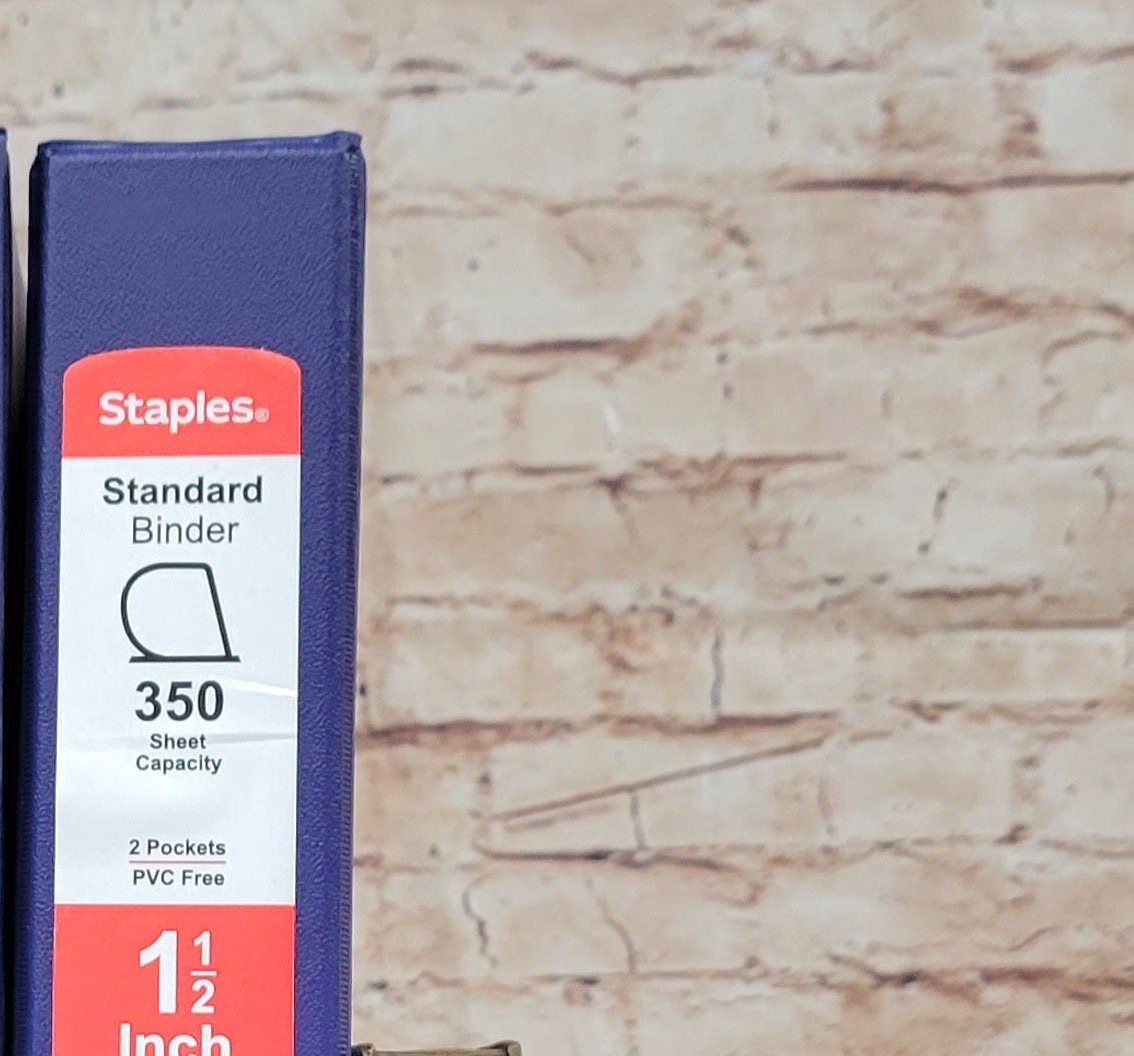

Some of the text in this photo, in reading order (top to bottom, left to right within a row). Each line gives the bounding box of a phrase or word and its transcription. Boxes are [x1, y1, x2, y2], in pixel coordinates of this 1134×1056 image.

[103, 475, 263, 505] Standard
[132, 515, 240, 544] Binder
[134, 680, 225, 722] 350
[149, 732, 207, 750] Sheet
[135, 754, 223, 774] Capacity
[129, 838, 226, 856] 2 Pockets
[133, 869, 225, 886] PVC Free
[139, 930, 178, 1014] 1
